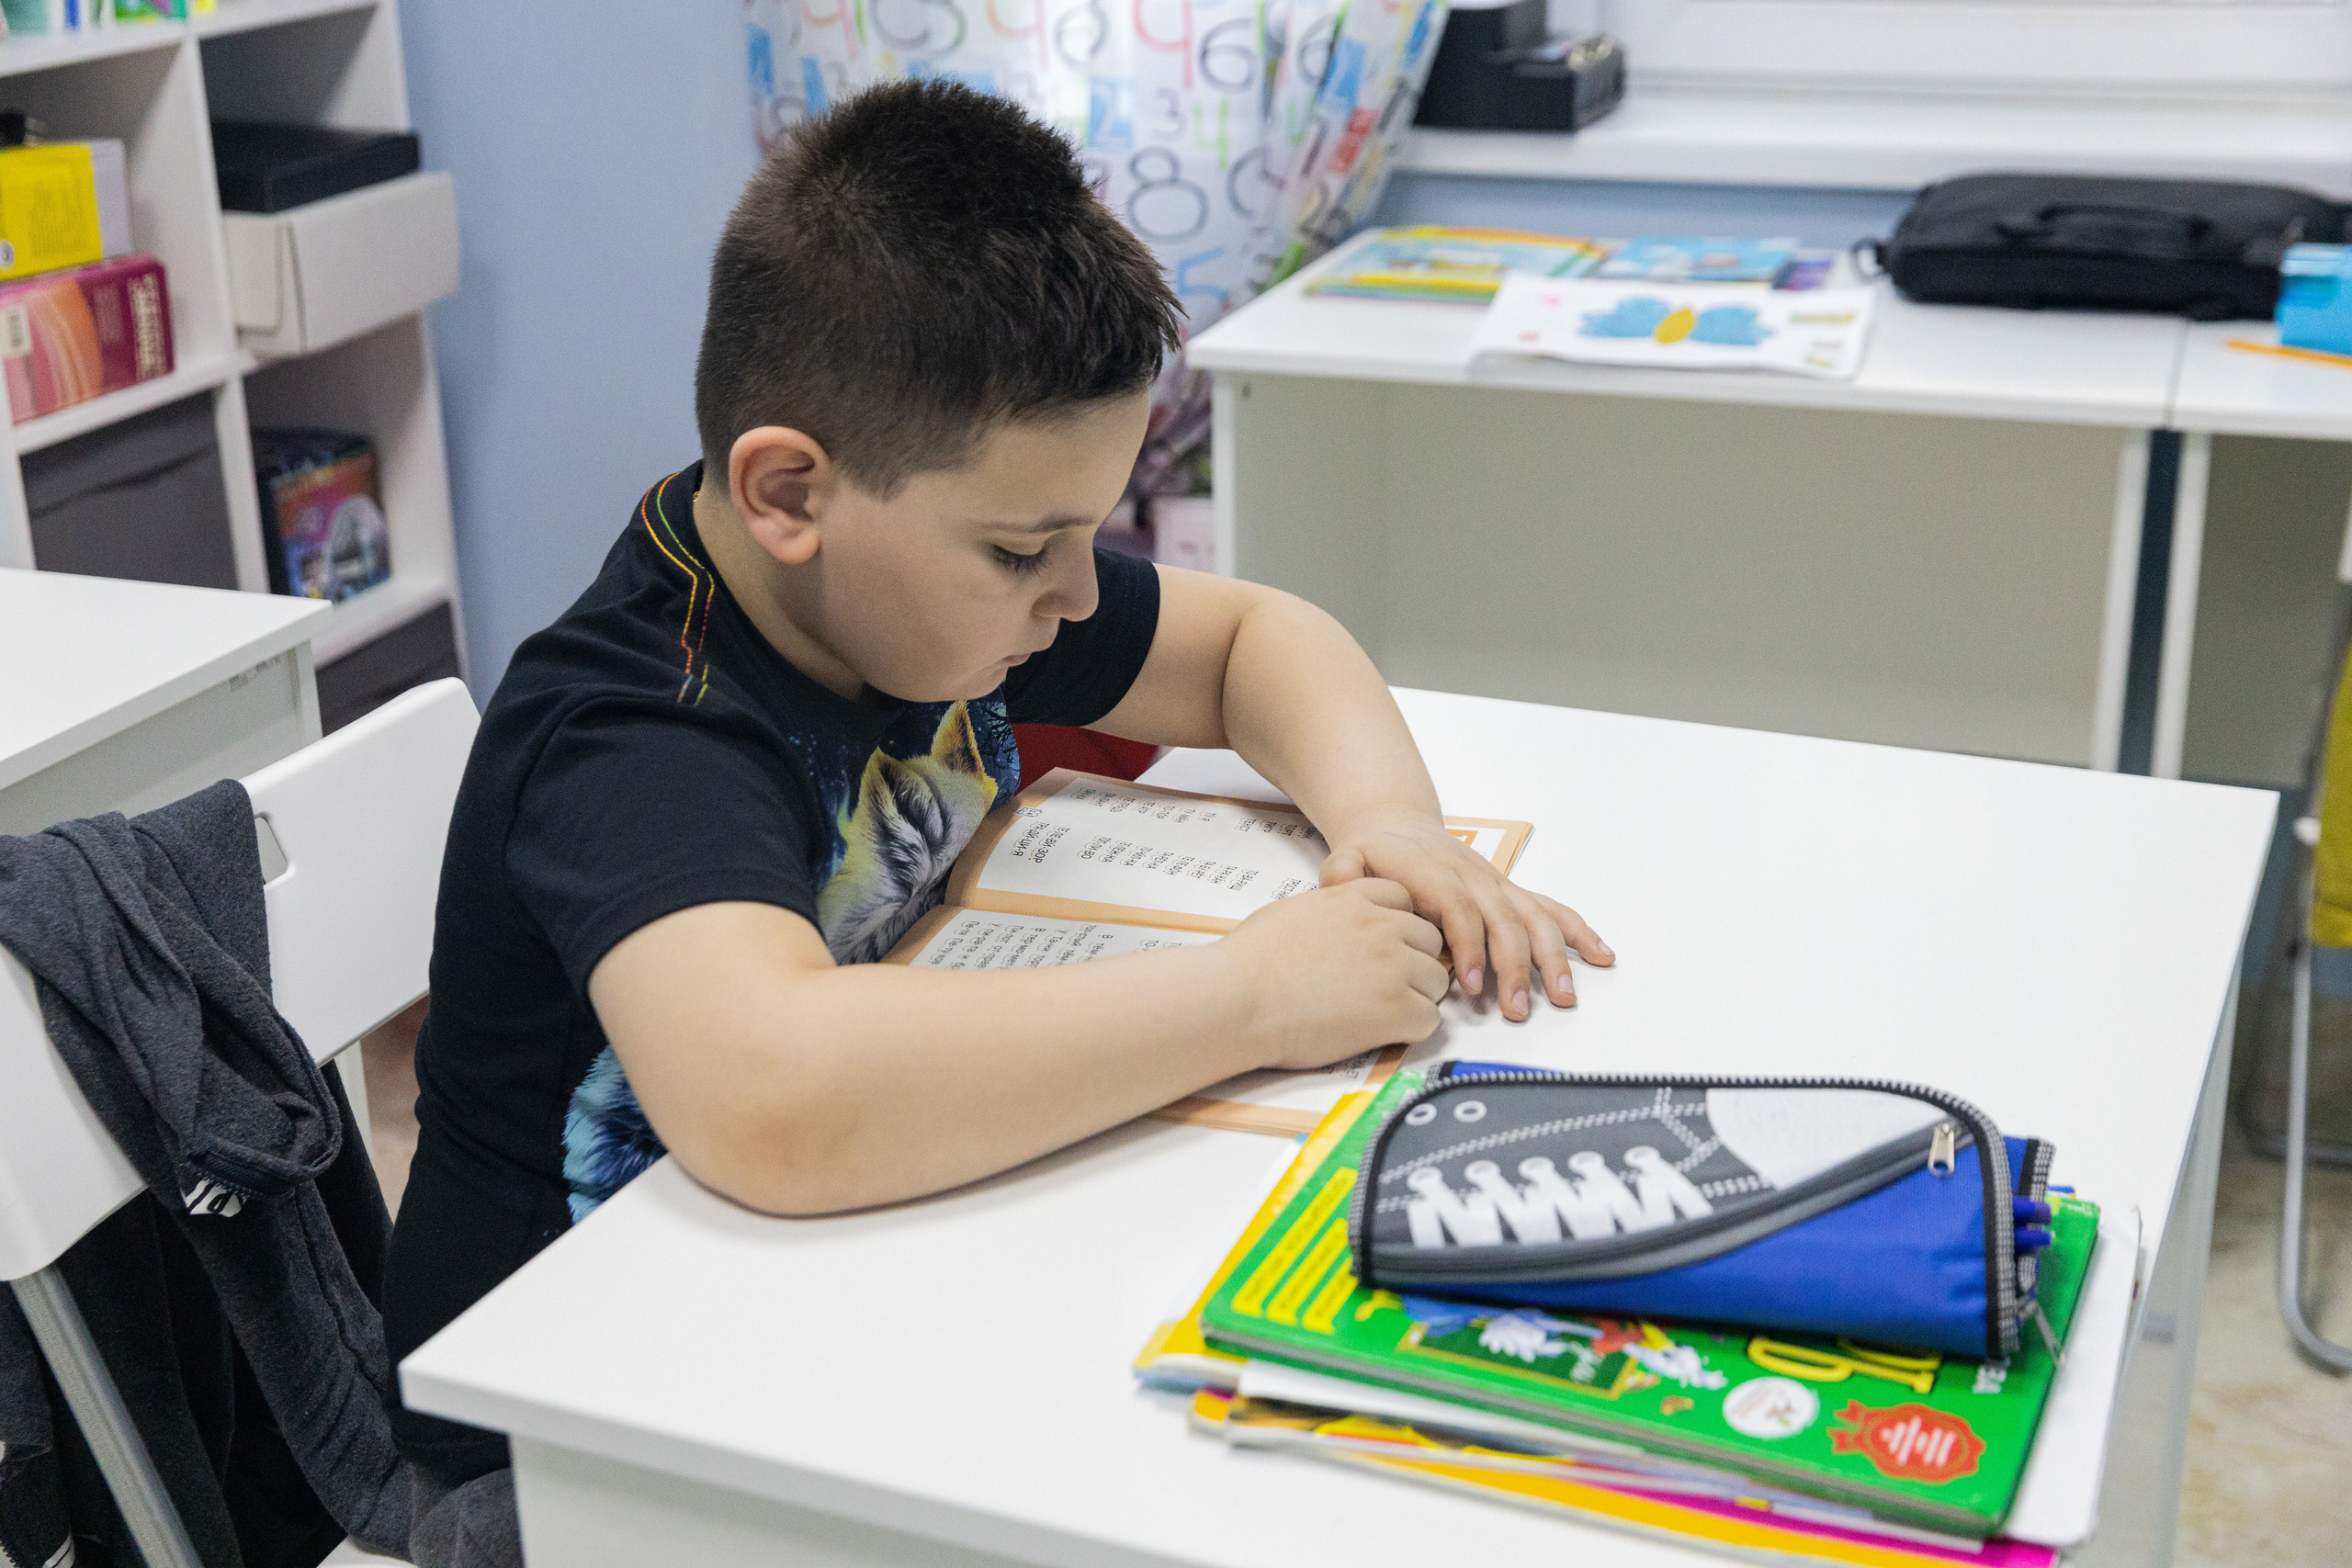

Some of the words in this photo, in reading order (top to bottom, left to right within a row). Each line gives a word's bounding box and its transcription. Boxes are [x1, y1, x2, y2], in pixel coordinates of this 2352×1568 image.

[1199, 17, 1257, 90] 6
[1126, 145, 1210, 244] 8
[1238, 818, 1257, 832] ТЕКСТ
[1263, 820, 1277, 833] ТИГР
[1282, 823, 1297, 837] ТОРТ
[960, 920, 980, 935] Пе-тя
[1001, 925, 1024, 943] Пи-лот
[969, 929, 994, 953] пи-ра-та
[1042, 936, 1064, 953] Та-ни
[1008, 933, 1039, 967] тер-мо-мет-
